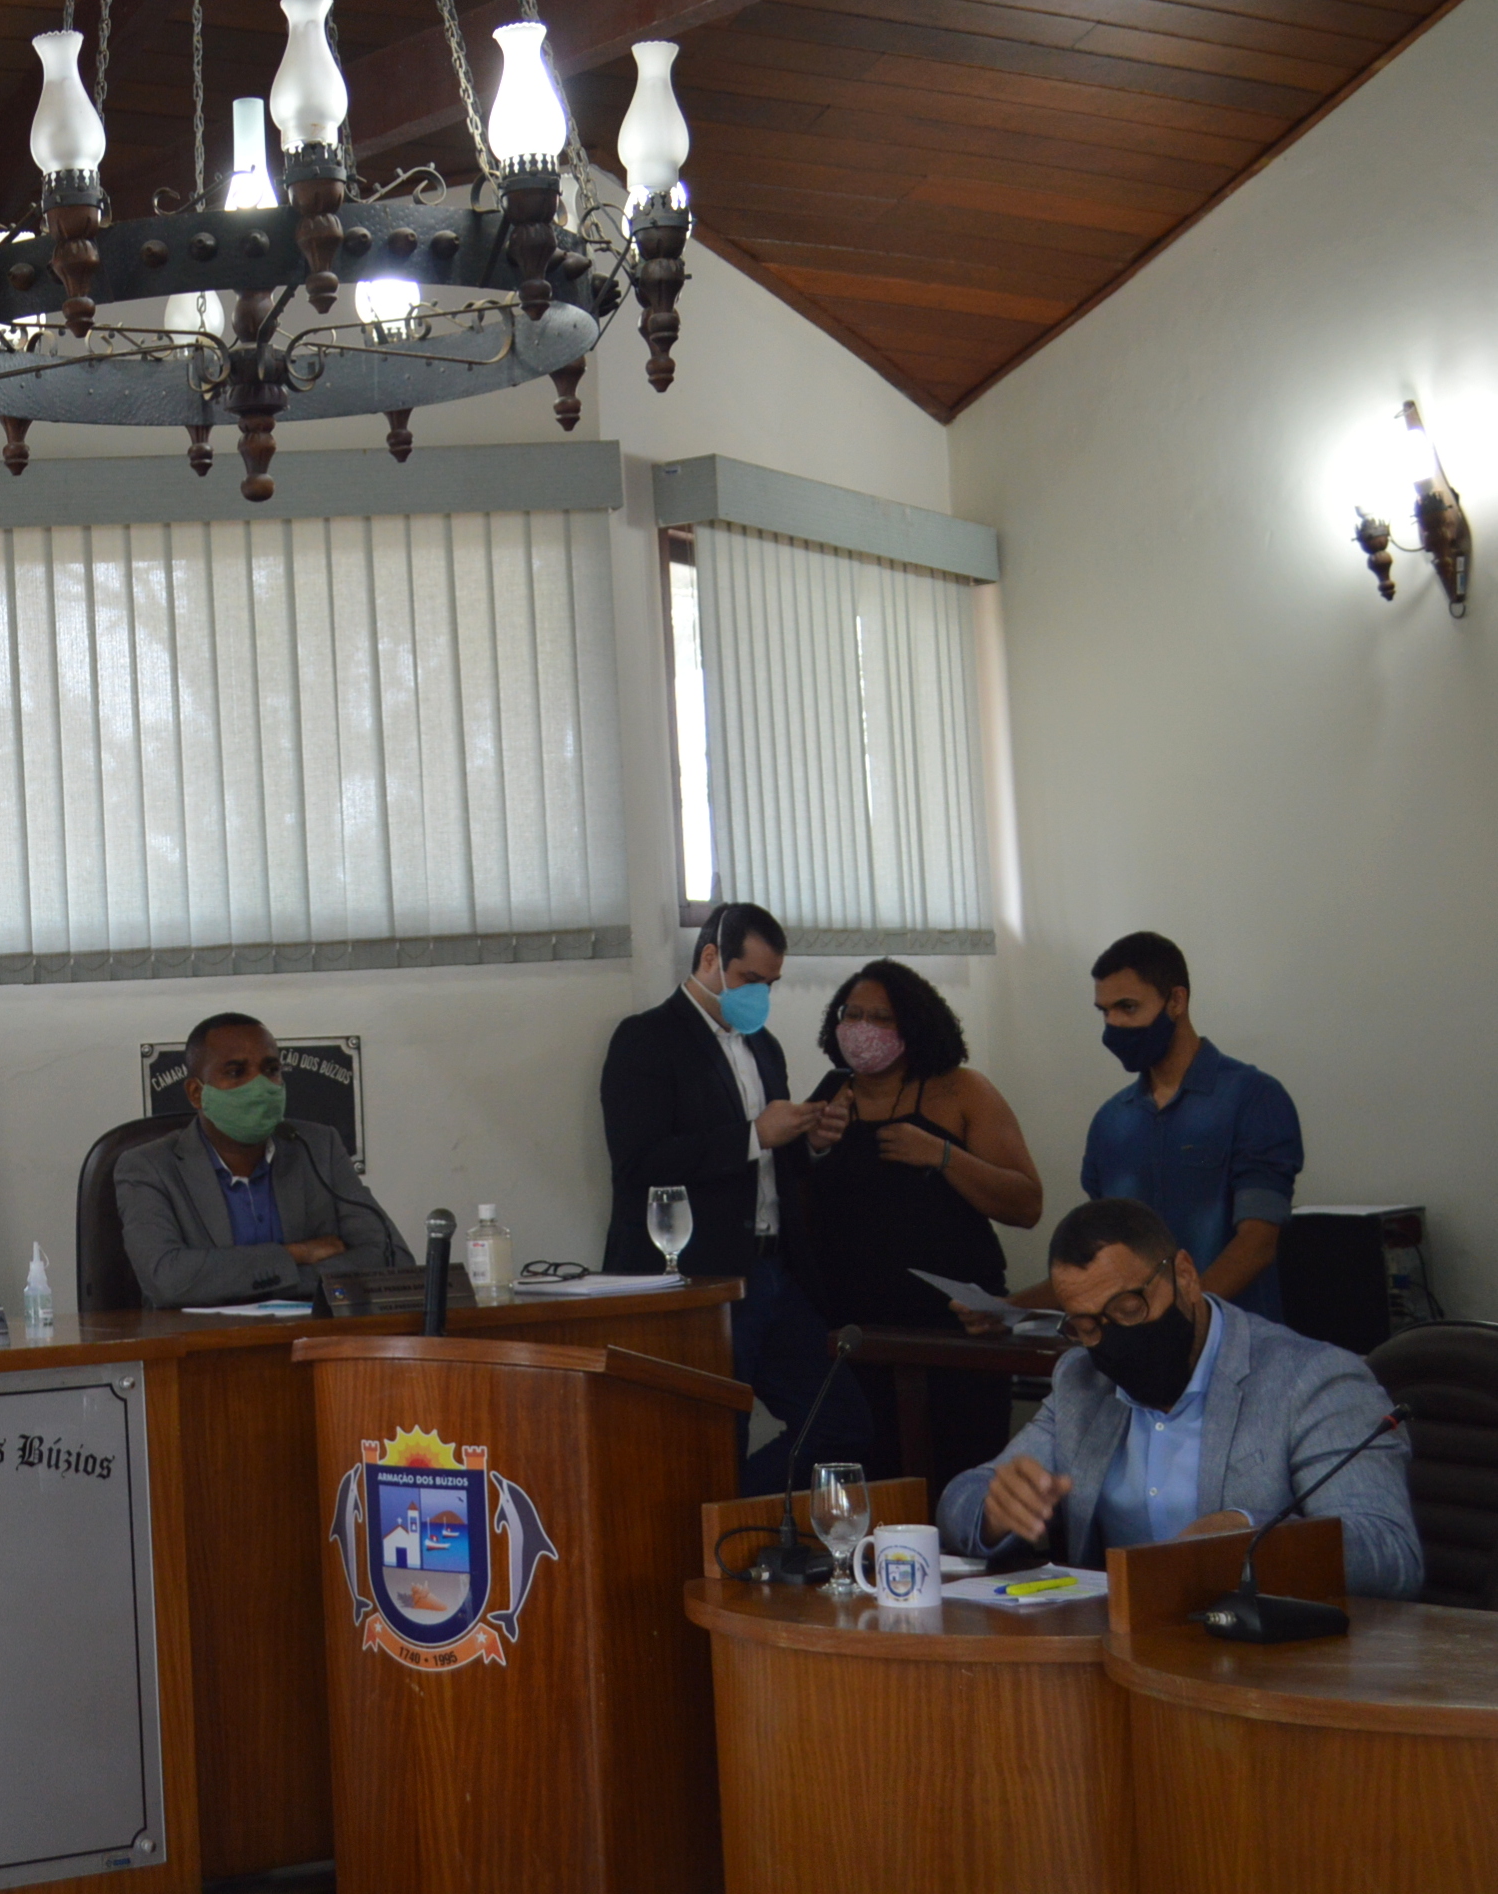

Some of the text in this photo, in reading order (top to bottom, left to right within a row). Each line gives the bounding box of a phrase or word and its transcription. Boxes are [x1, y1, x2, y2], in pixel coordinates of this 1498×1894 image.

[152, 1063, 188, 1092] CÂMARA
[300, 1053, 320, 1072] DOS
[319, 1060, 352, 1085] BÚZIOS
[15, 1433, 116, 1480] Búzios
[377, 1472, 469, 1487] ARMAÇÃO DOS BÚZIOS
[399, 1646, 459, 1667] 1740 1995
